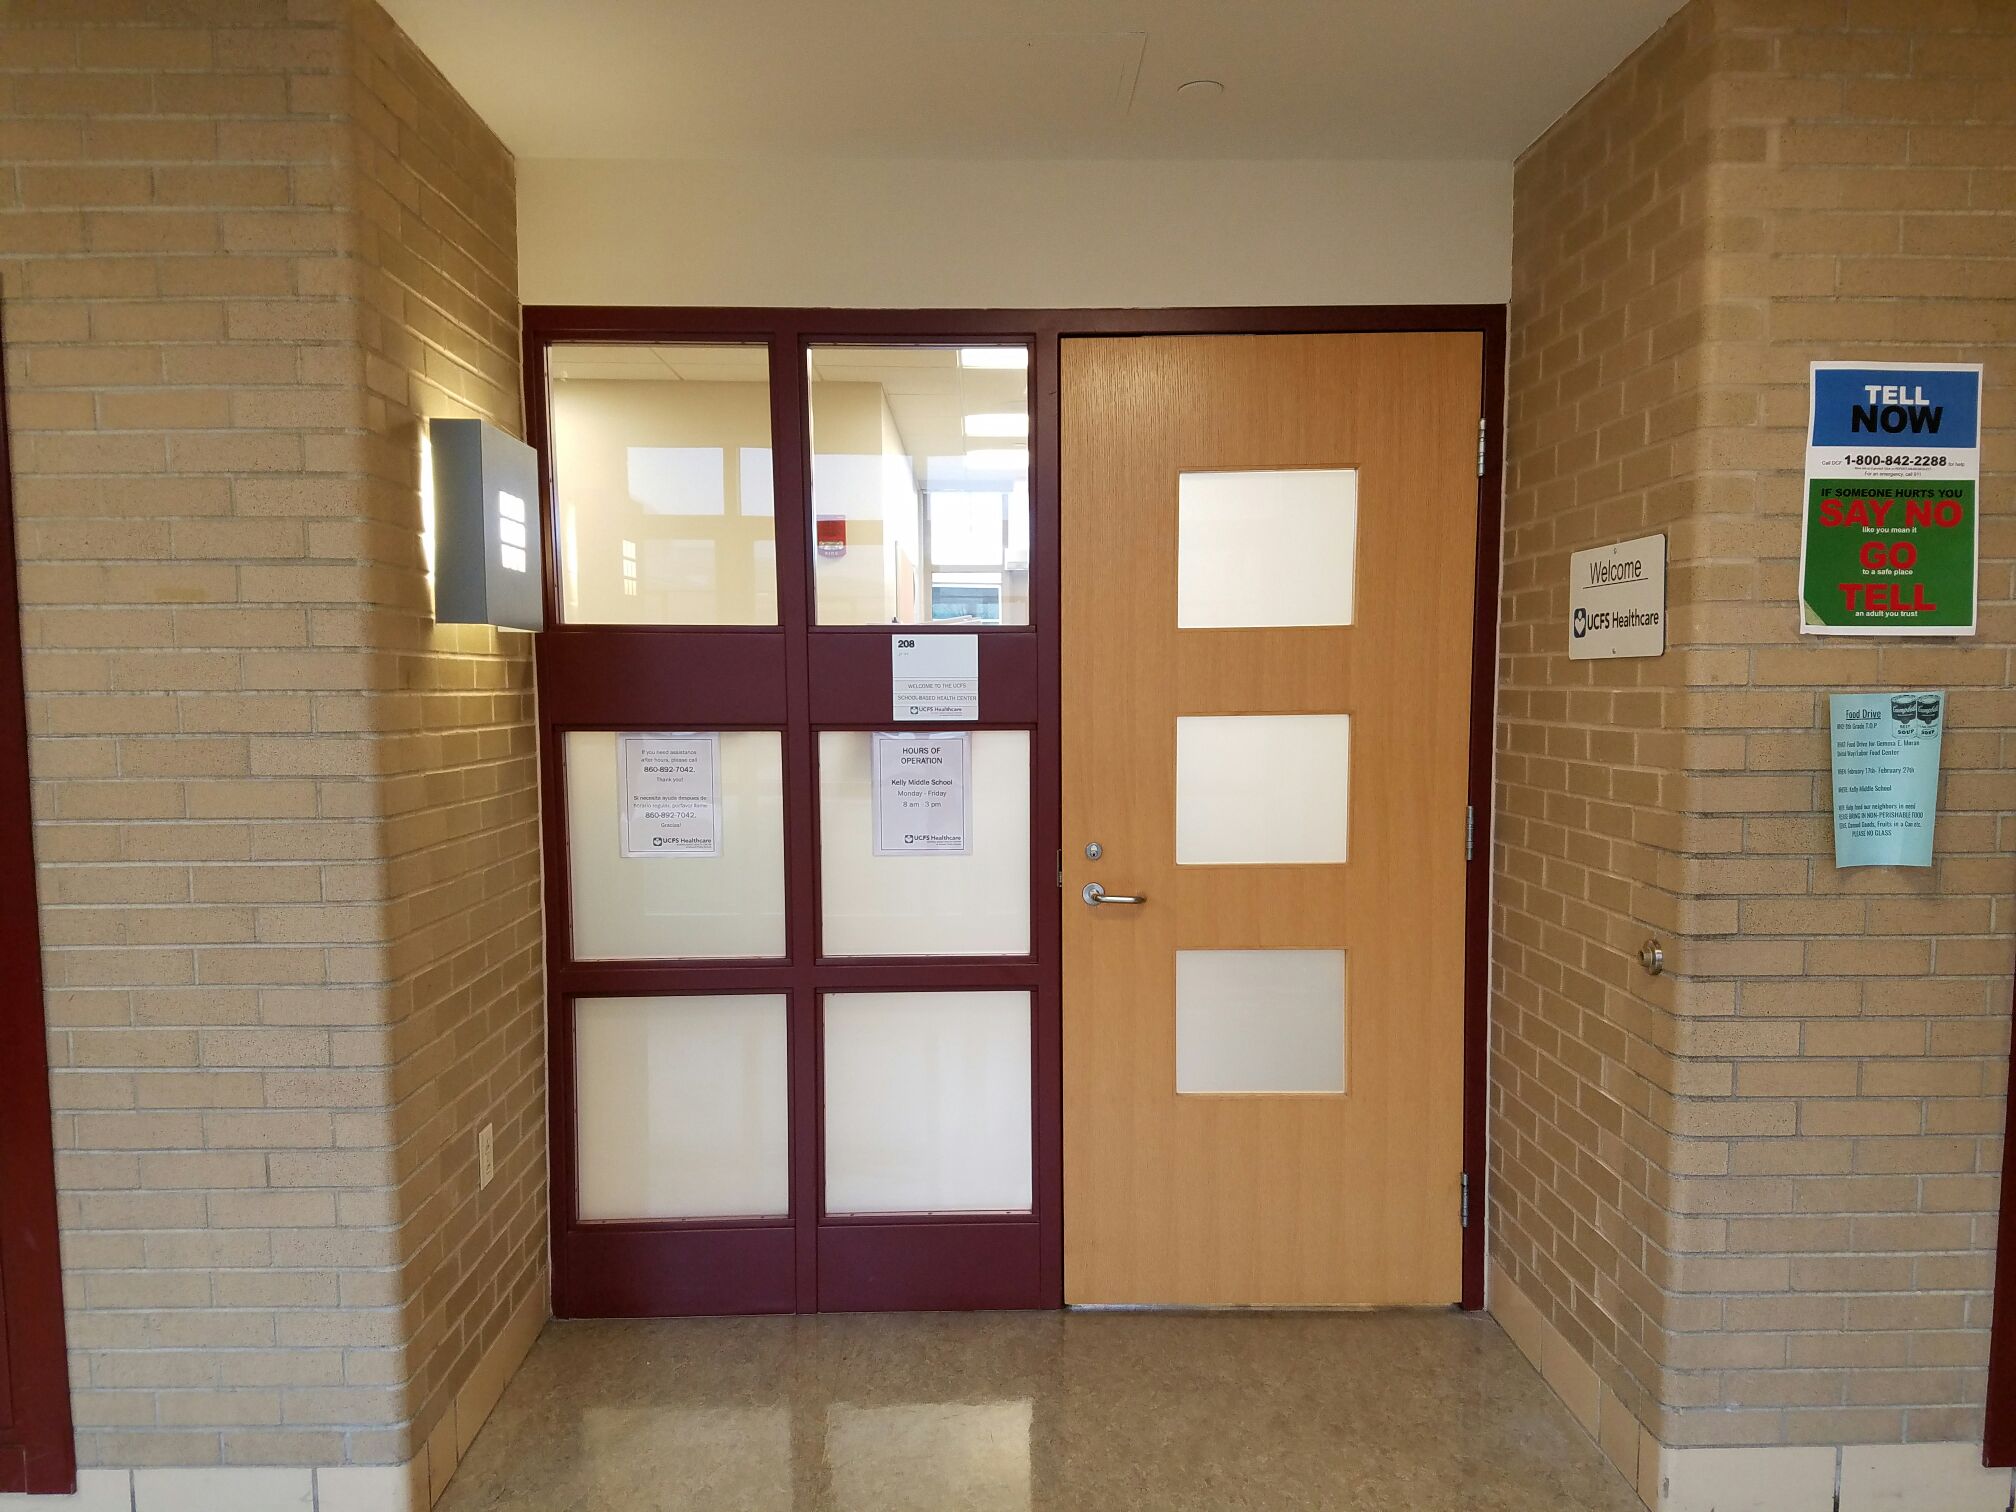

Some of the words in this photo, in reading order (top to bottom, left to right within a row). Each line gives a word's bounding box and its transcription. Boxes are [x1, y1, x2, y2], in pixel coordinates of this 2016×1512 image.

[1865, 385, 1930, 405] TELL
[1851, 405, 1944, 434] NOW
[1844, 455, 1947, 467] 1-800-842-2288
[1821, 488, 1832, 497] IF
[1835, 488, 1891, 498] SOMEONE
[1895, 488, 1935, 498] HURTS
[1938, 489, 1963, 498] YOU
[1819, 498, 1895, 528] SAY
[1905, 499, 1964, 528] NO
[1876, 527, 1889, 535] you
[1859, 541, 1918, 569] GO
[1590, 559, 1642, 584] Welcome
[1893, 569, 1913, 577] place
[1838, 583, 1937, 612] TELL
[1587, 612, 1610, 630] UCFS
[1612, 608, 1659, 628] Healthcare
[898, 639, 915, 648] 208
[1845, 709, 1860, 719] Food
[1862, 709, 1881, 719] Drive
[900, 757, 943, 765] OPERATION
[1878, 766, 1902, 775] February
[891, 779, 907, 787] Kelly
[897, 790, 922, 798] Monday
[1871, 803, 1897, 811] neighbors
[645, 811, 697, 819] 860-892-7042.
[1867, 811, 1911, 819] NON-PERISHABLE
[1911, 811, 1924, 819] FOOD
[1877, 820, 1893, 828] Fruits
[1874, 829, 1892, 837] GLASS
